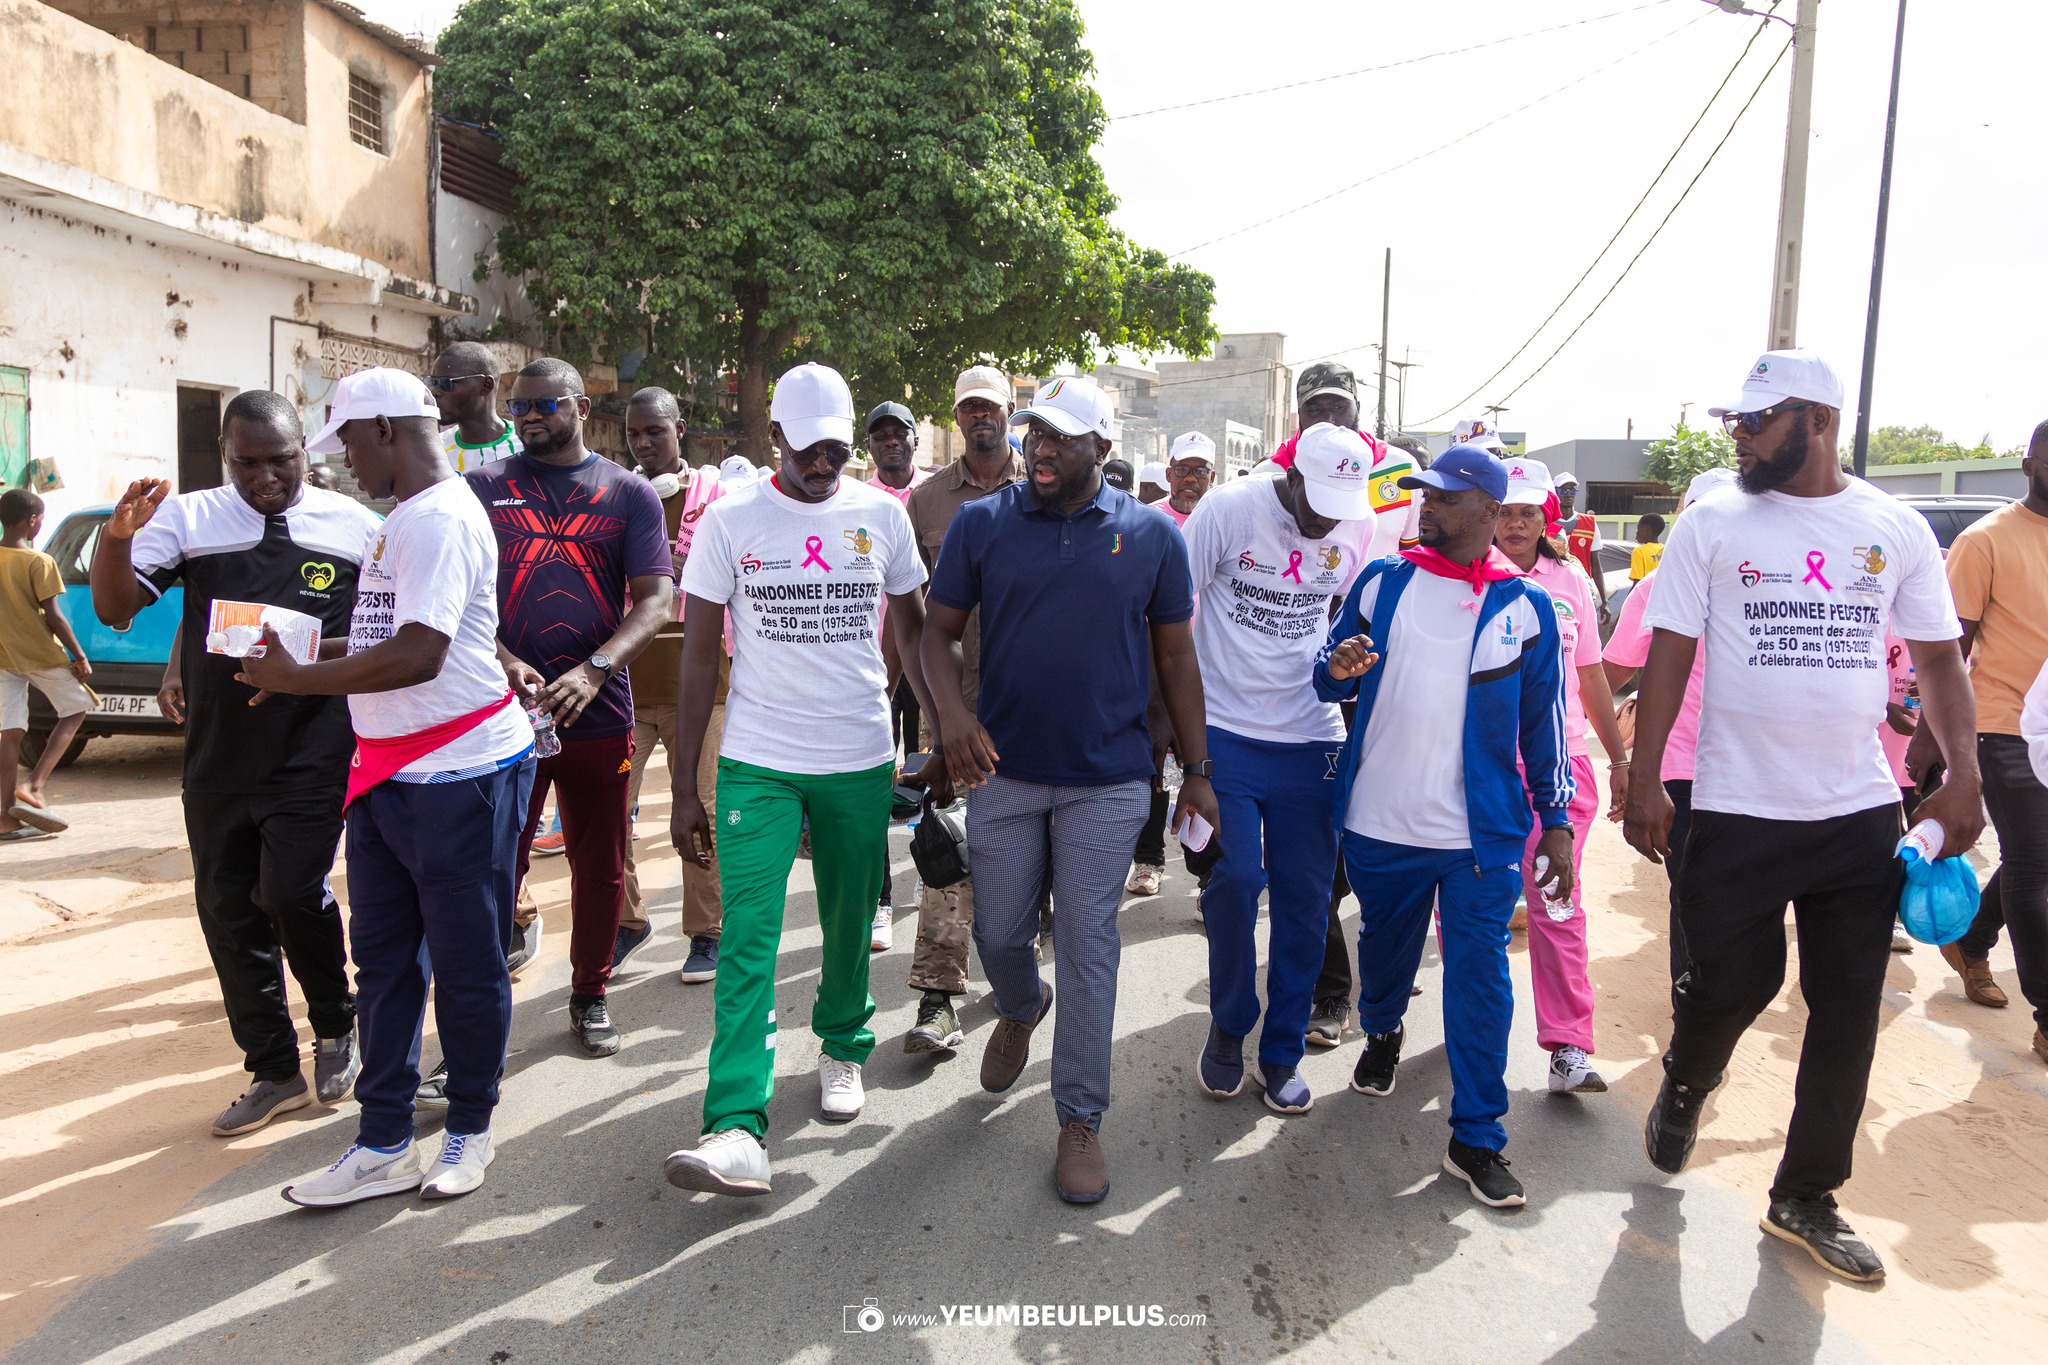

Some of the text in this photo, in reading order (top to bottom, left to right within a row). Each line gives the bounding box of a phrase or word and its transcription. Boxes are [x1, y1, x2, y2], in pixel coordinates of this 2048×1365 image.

[1860, 575, 1877, 583] ANS
[745, 582, 880, 600] RANDONNEE PEDESTRE
[1230, 577, 1291, 607] RANDONNEE
[753, 601, 763, 612] de
[764, 603, 820, 615] Lancement
[823, 603, 840, 614] des
[1236, 602, 1250, 614] des
[1251, 605, 1266, 622] 50
[1265, 618, 1279, 629] ans
[1744, 600, 1826, 620] RANDONNEE
[761, 615, 778, 628] des
[780, 616, 798, 629] 50
[801, 620, 819, 629] ans
[1235, 614, 1279, 637] Célébration
[764, 629, 821, 644] Célébration
[823, 630, 857, 643] Octobre
[1562, 633, 1574, 642] ntre
[1750, 624, 1761, 636] de
[1764, 623, 1824, 636] Lancement
[1827, 624, 1844, 637] des
[1757, 638, 1775, 651] des
[1778, 637, 1798, 651] 50
[1802, 641, 1821, 652] ans
[1749, 654, 1757, 666] et
[1760, 653, 1824, 668] Célébration
[1827, 656, 1862, 669] Octobre
[101, 697, 124, 712] 104
[130, 698, 147, 712] PF
